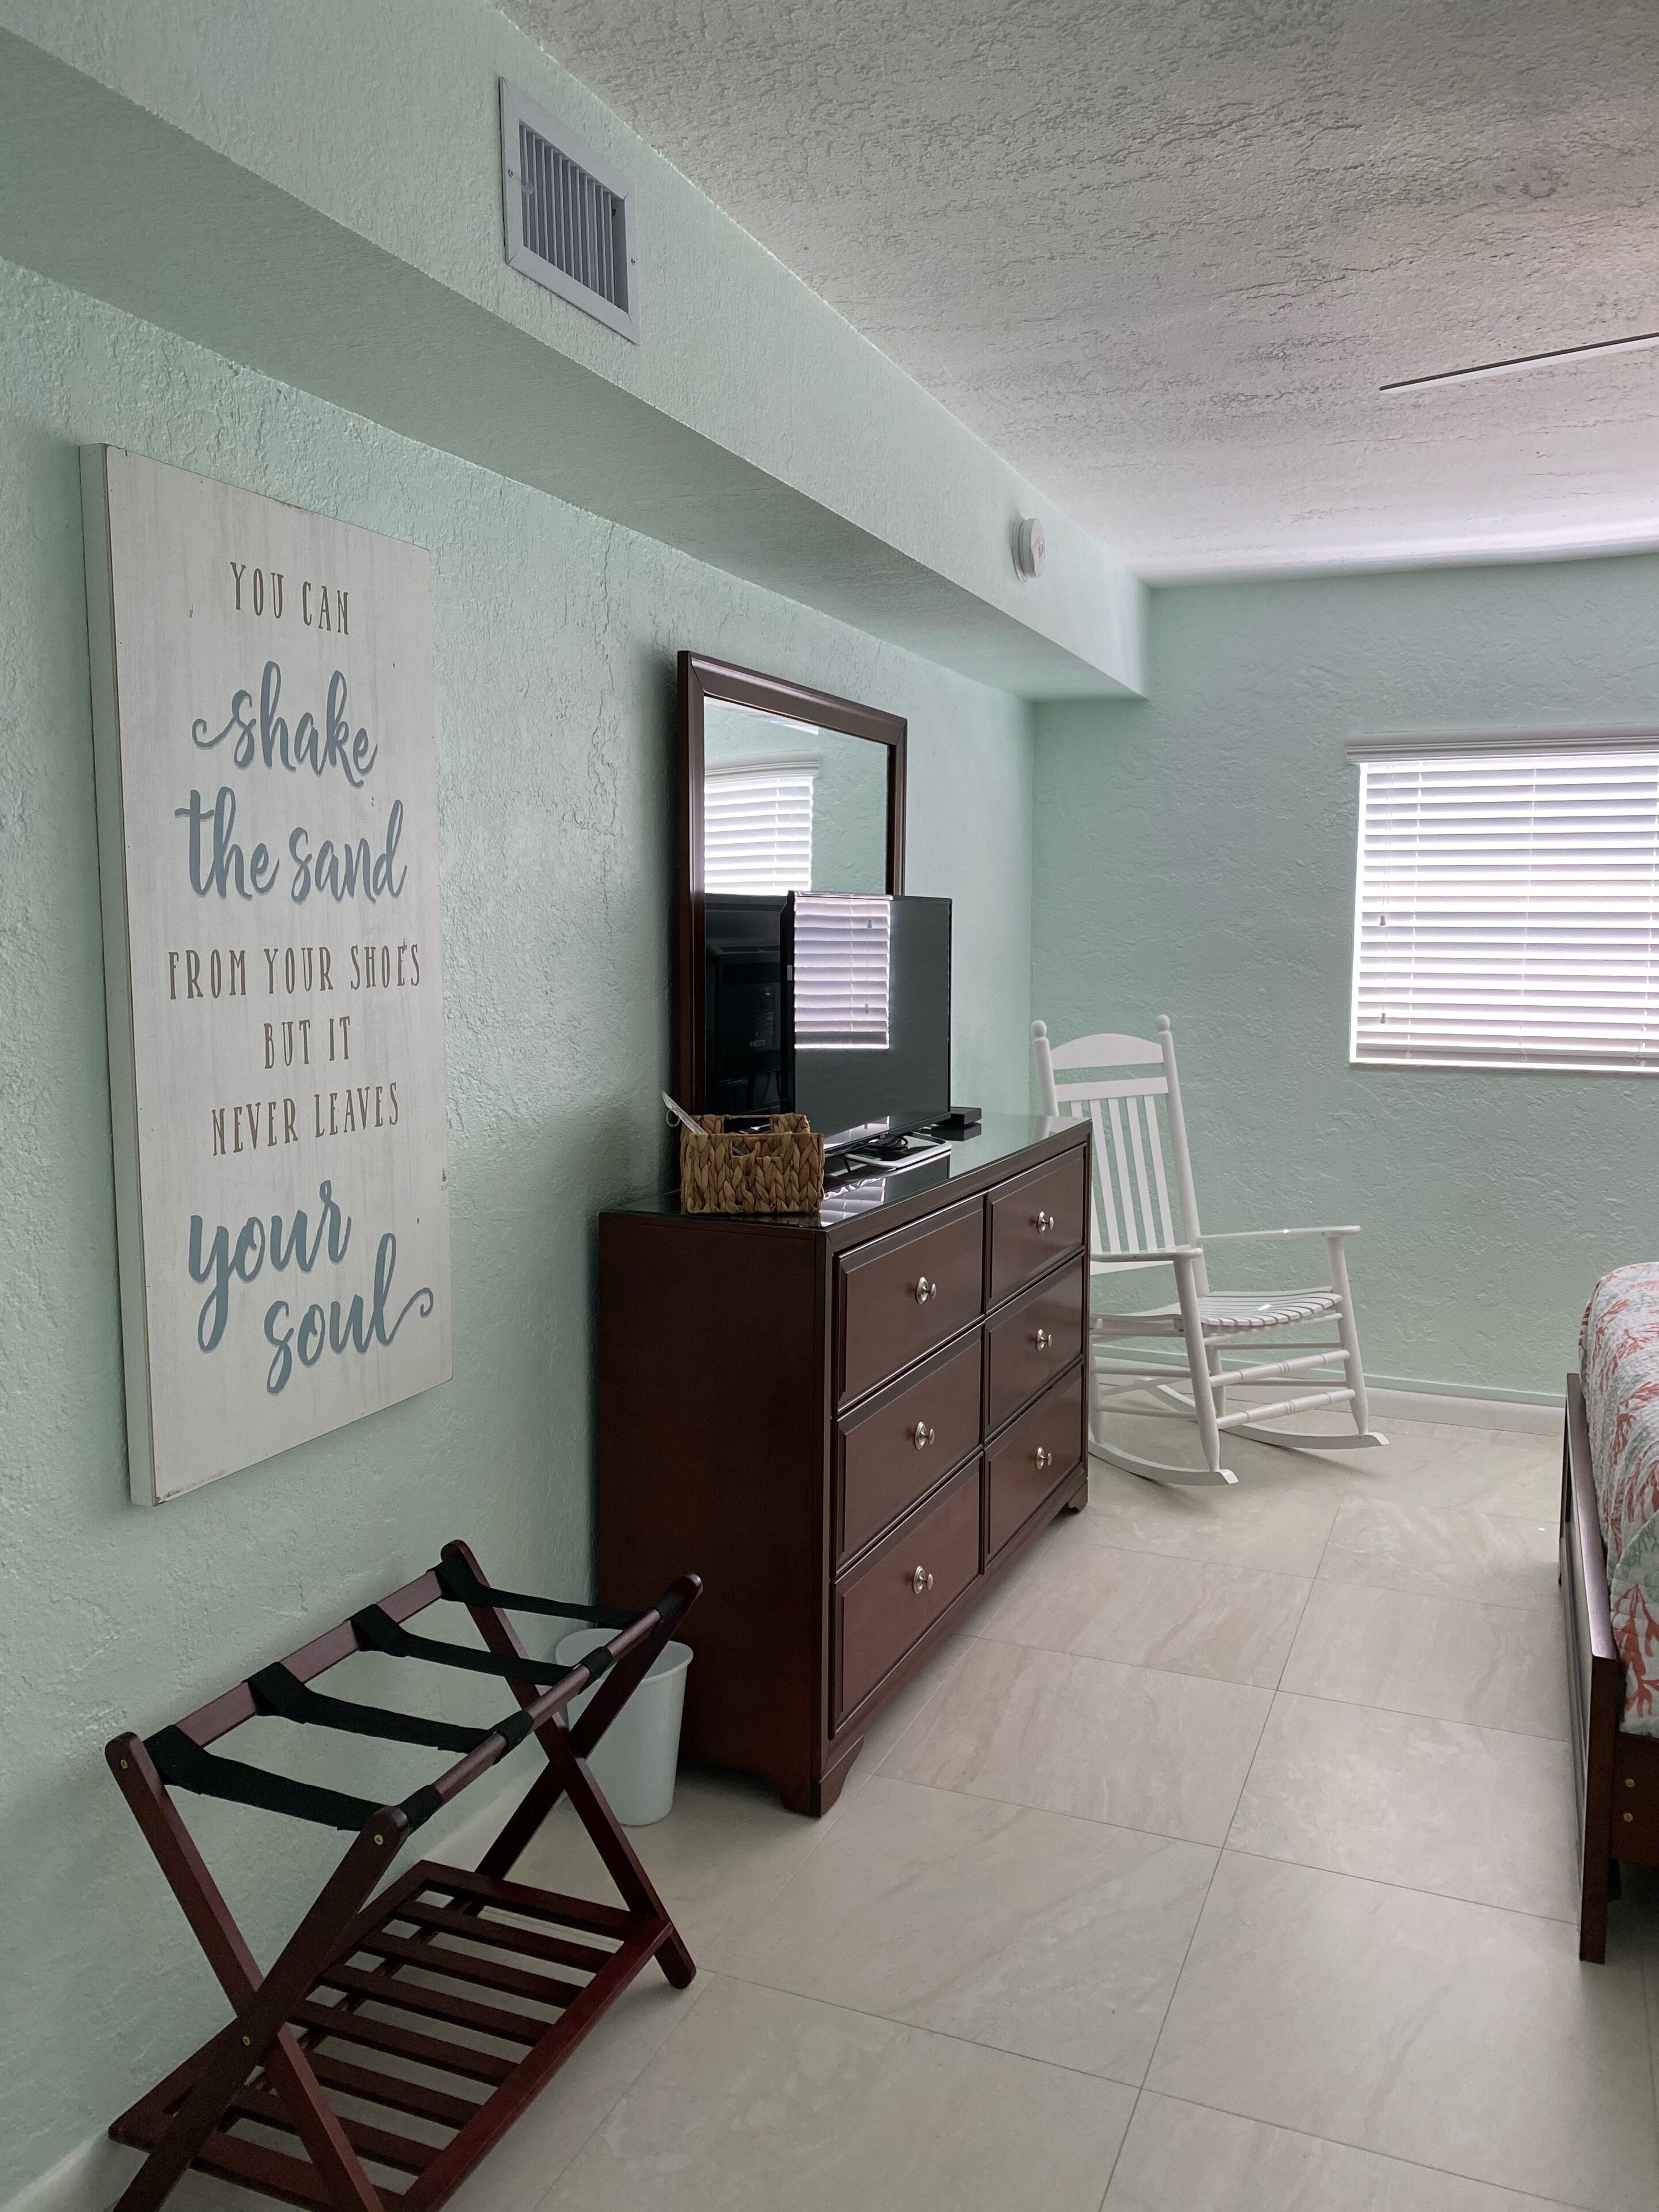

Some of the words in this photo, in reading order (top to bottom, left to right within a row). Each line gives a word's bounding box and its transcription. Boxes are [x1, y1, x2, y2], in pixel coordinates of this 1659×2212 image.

[230, 562, 284, 619] YOU
[302, 581, 349, 635] CAN
[192, 661, 378, 787] shake
[175, 786, 279, 899] the
[289, 800, 408, 904] sand
[168, 949, 247, 1000] FROM
[264, 944, 334, 994] YOUR
[350, 943, 421, 991] SHOES
[264, 1019, 311, 1070] BUT
[329, 1016, 351, 1062] IT
[212, 1097, 299, 1157] NEVER
[315, 1081, 400, 1138] LEAVES
[188, 1180, 351, 1353] your
[264, 1233, 433, 1395] soul
